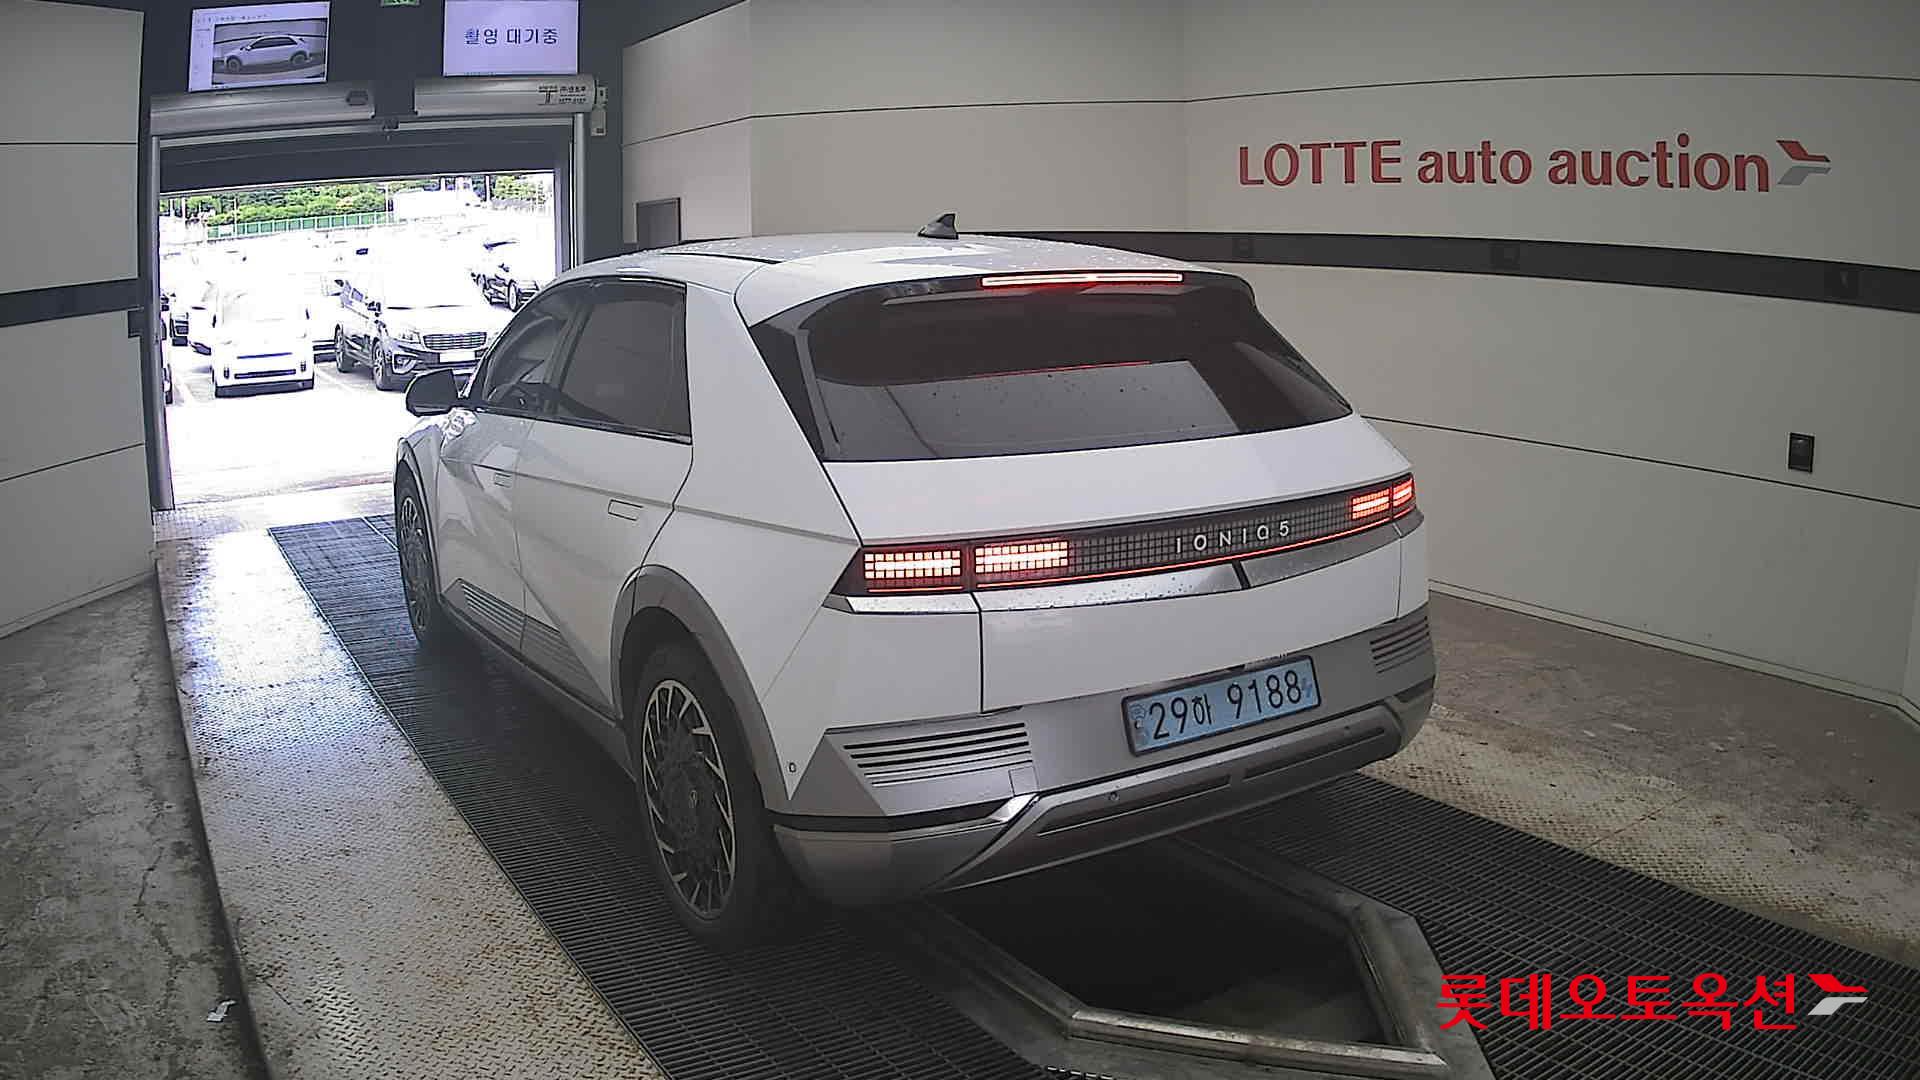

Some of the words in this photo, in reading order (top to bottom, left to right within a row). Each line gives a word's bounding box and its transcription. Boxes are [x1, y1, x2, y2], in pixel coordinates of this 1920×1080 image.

[506, 28, 558, 45] 대기중
[1239, 140, 1401, 186] LOTTE
[1417, 140, 1533, 185] auto
[1547, 133, 1770, 193] auction
[1149, 693, 1212, 740] 29하
[1227, 669, 1301, 720] 9188
